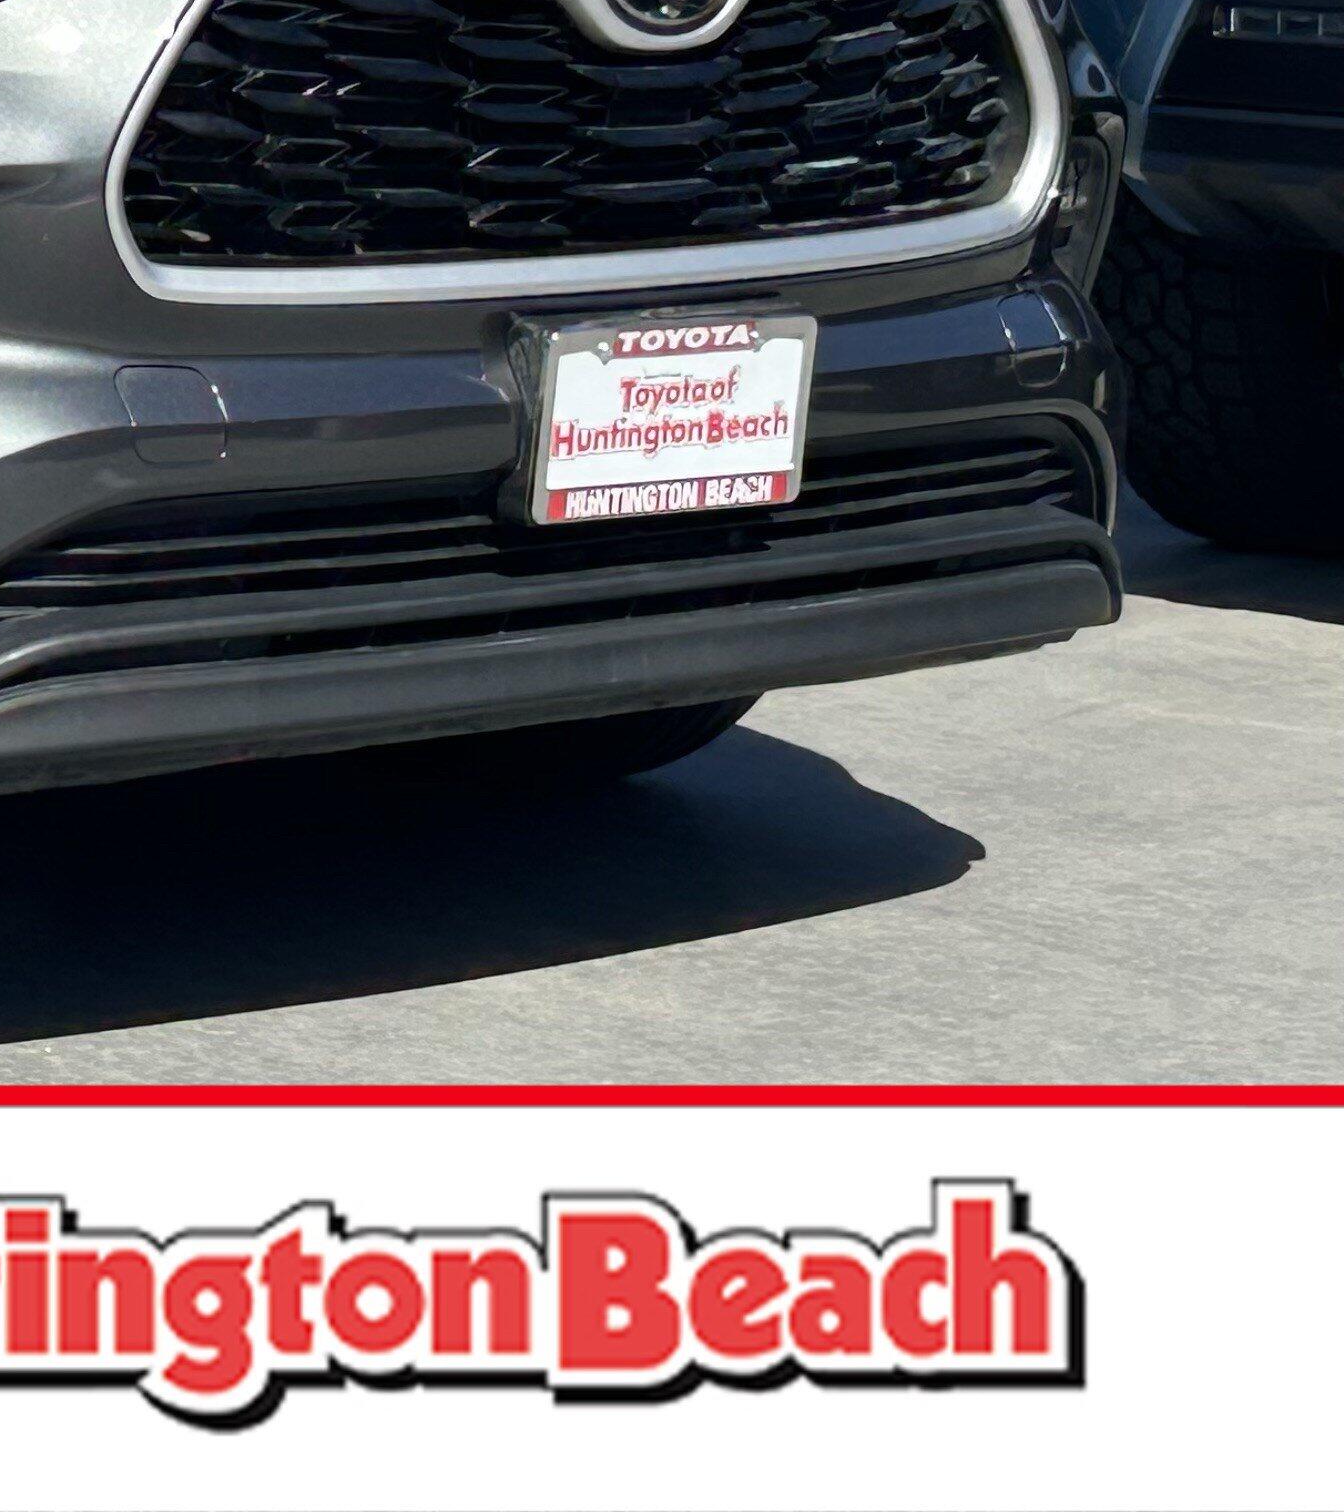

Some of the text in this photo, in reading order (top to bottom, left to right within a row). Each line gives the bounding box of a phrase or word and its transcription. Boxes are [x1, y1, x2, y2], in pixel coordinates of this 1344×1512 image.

[617, 324, 750, 352] TOYOTA
[619, 365, 741, 413] Toyota of
[551, 400, 789, 459] Huntington Beach
[564, 474, 774, 519] HUNTINGTON BEACH
